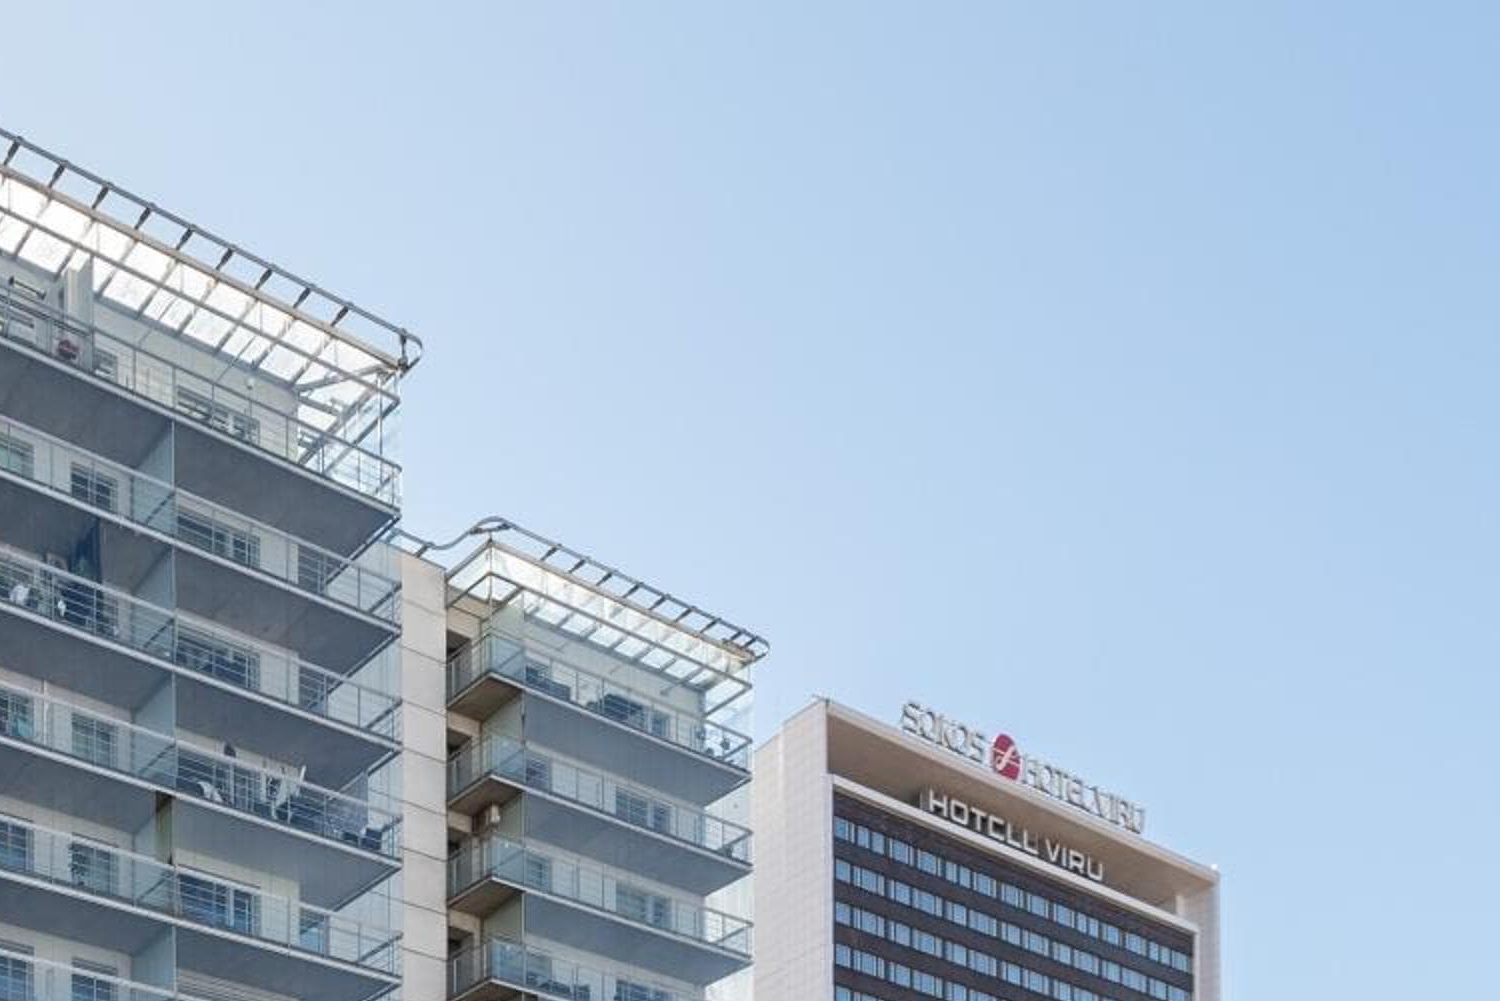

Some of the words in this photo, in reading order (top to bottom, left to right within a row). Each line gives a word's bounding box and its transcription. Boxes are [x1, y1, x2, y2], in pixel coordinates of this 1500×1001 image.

[902, 702, 985, 763] SOKOS
[928, 789, 1040, 856] HOTELL
[1044, 838, 1104, 880] VIRU
